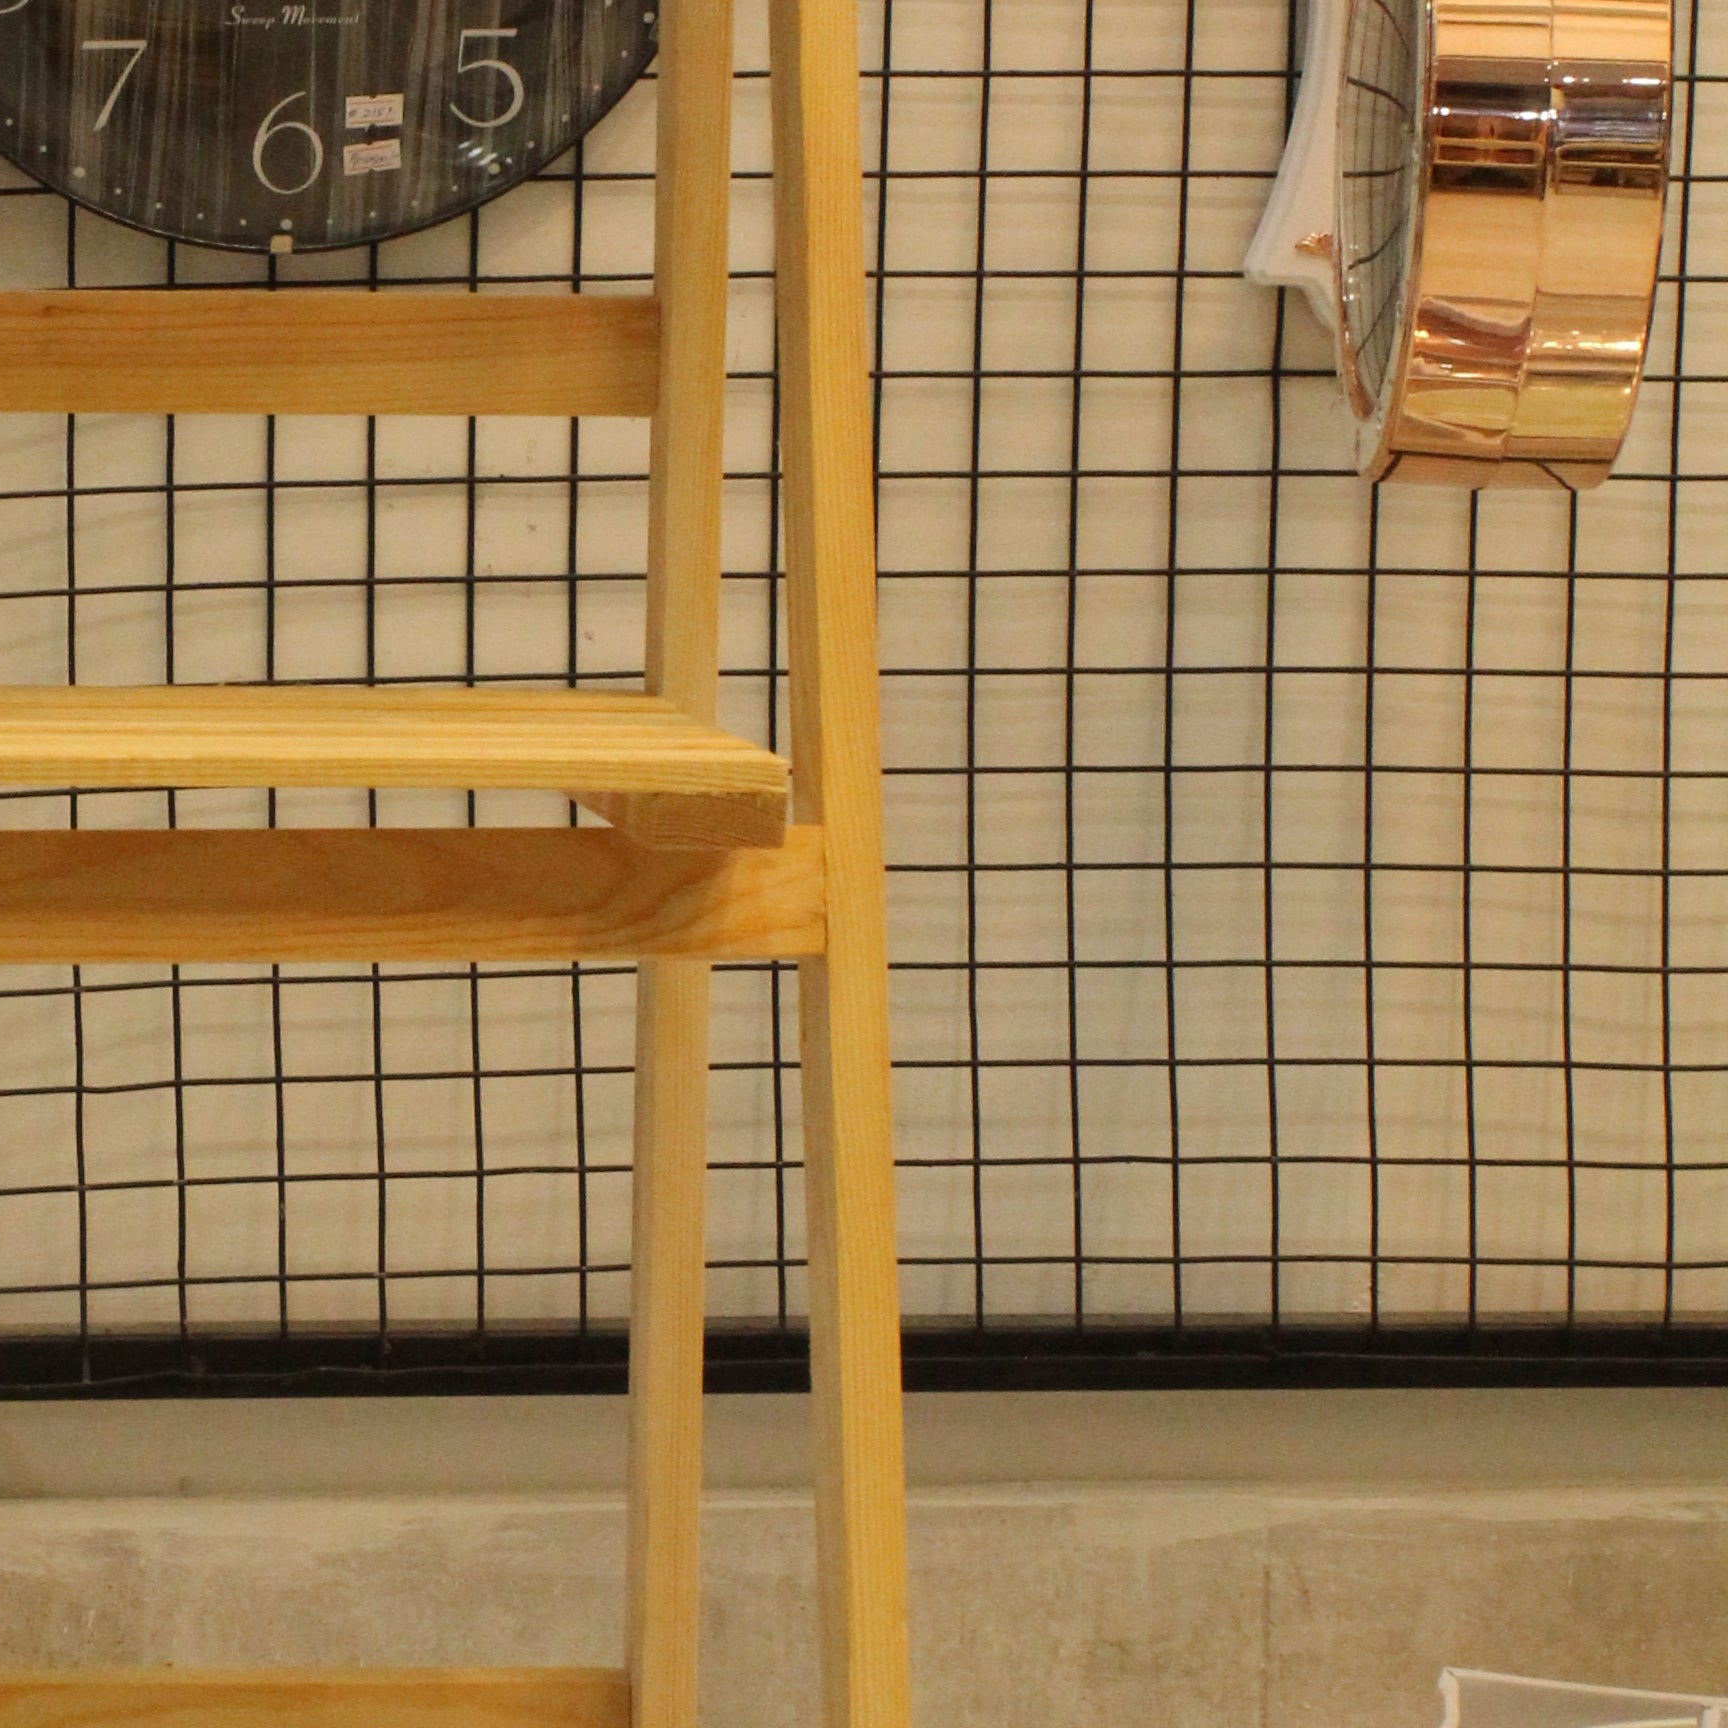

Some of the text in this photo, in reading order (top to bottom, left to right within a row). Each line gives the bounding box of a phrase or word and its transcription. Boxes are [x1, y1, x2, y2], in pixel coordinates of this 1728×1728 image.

[80, 38, 148, 134] 7
[448, 26, 525, 130] 5
[251, 90, 324, 196] 6
